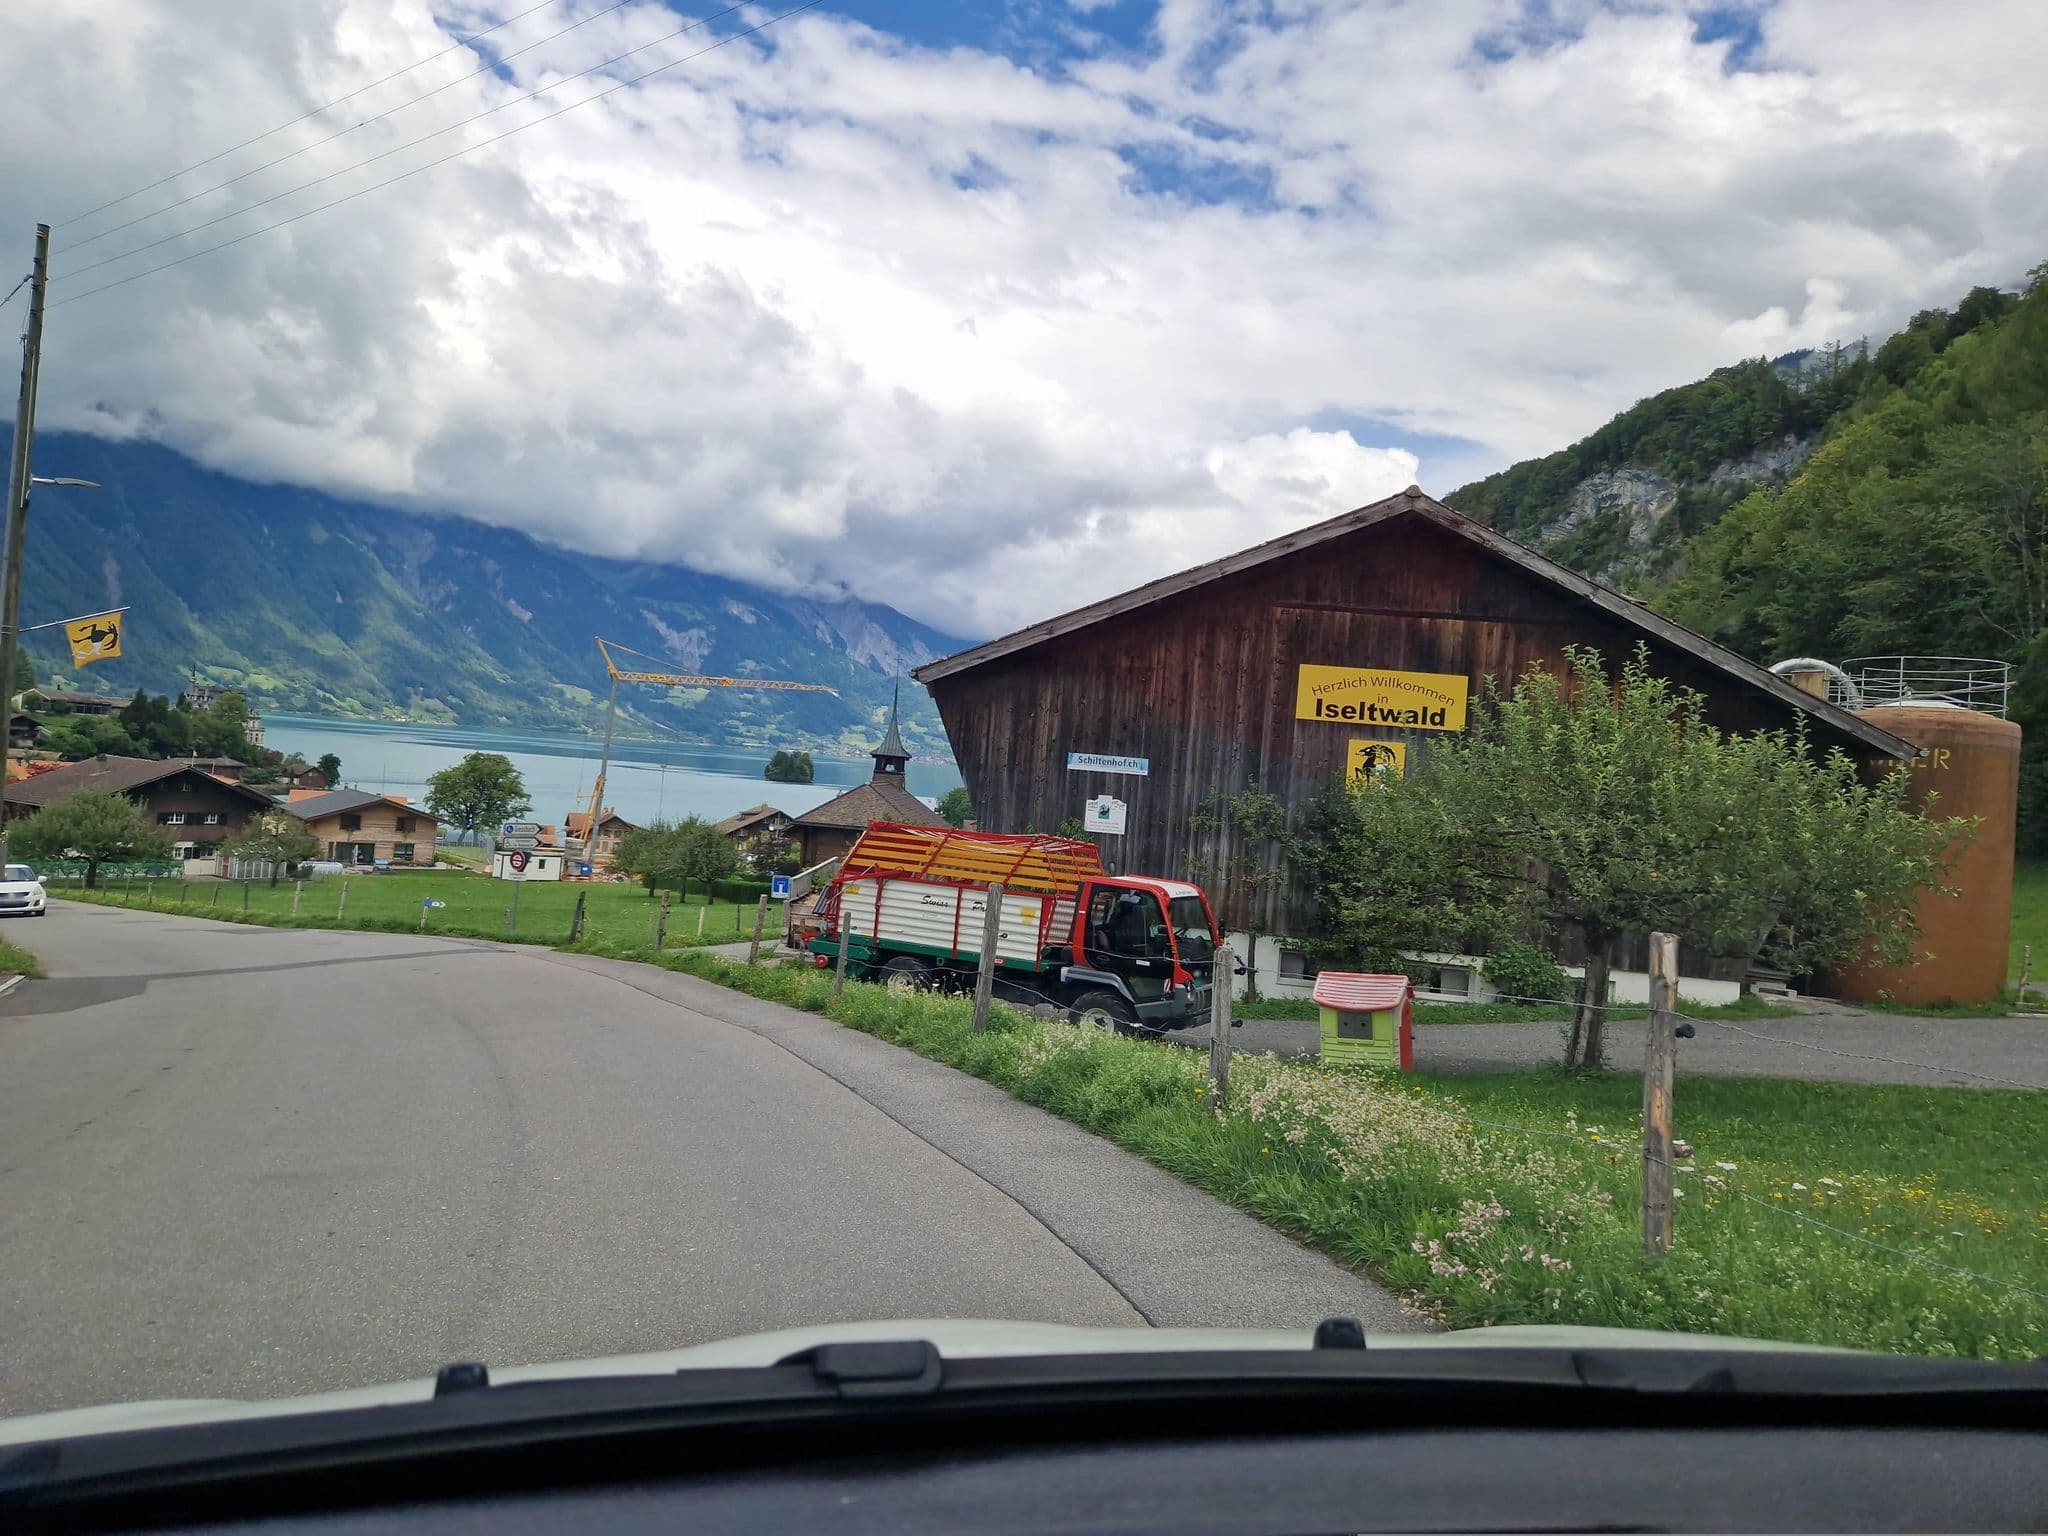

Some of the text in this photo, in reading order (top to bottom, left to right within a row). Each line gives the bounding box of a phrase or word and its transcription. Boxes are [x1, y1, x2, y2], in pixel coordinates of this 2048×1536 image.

[1312, 676, 1455, 706] Herzlich Willkommen
[1377, 693, 1389, 704] in
[1315, 698, 1446, 727] Iseltwald
[1078, 756, 1138, 769] Schiltenhof.ch
[921, 895, 949, 907] Swiss
